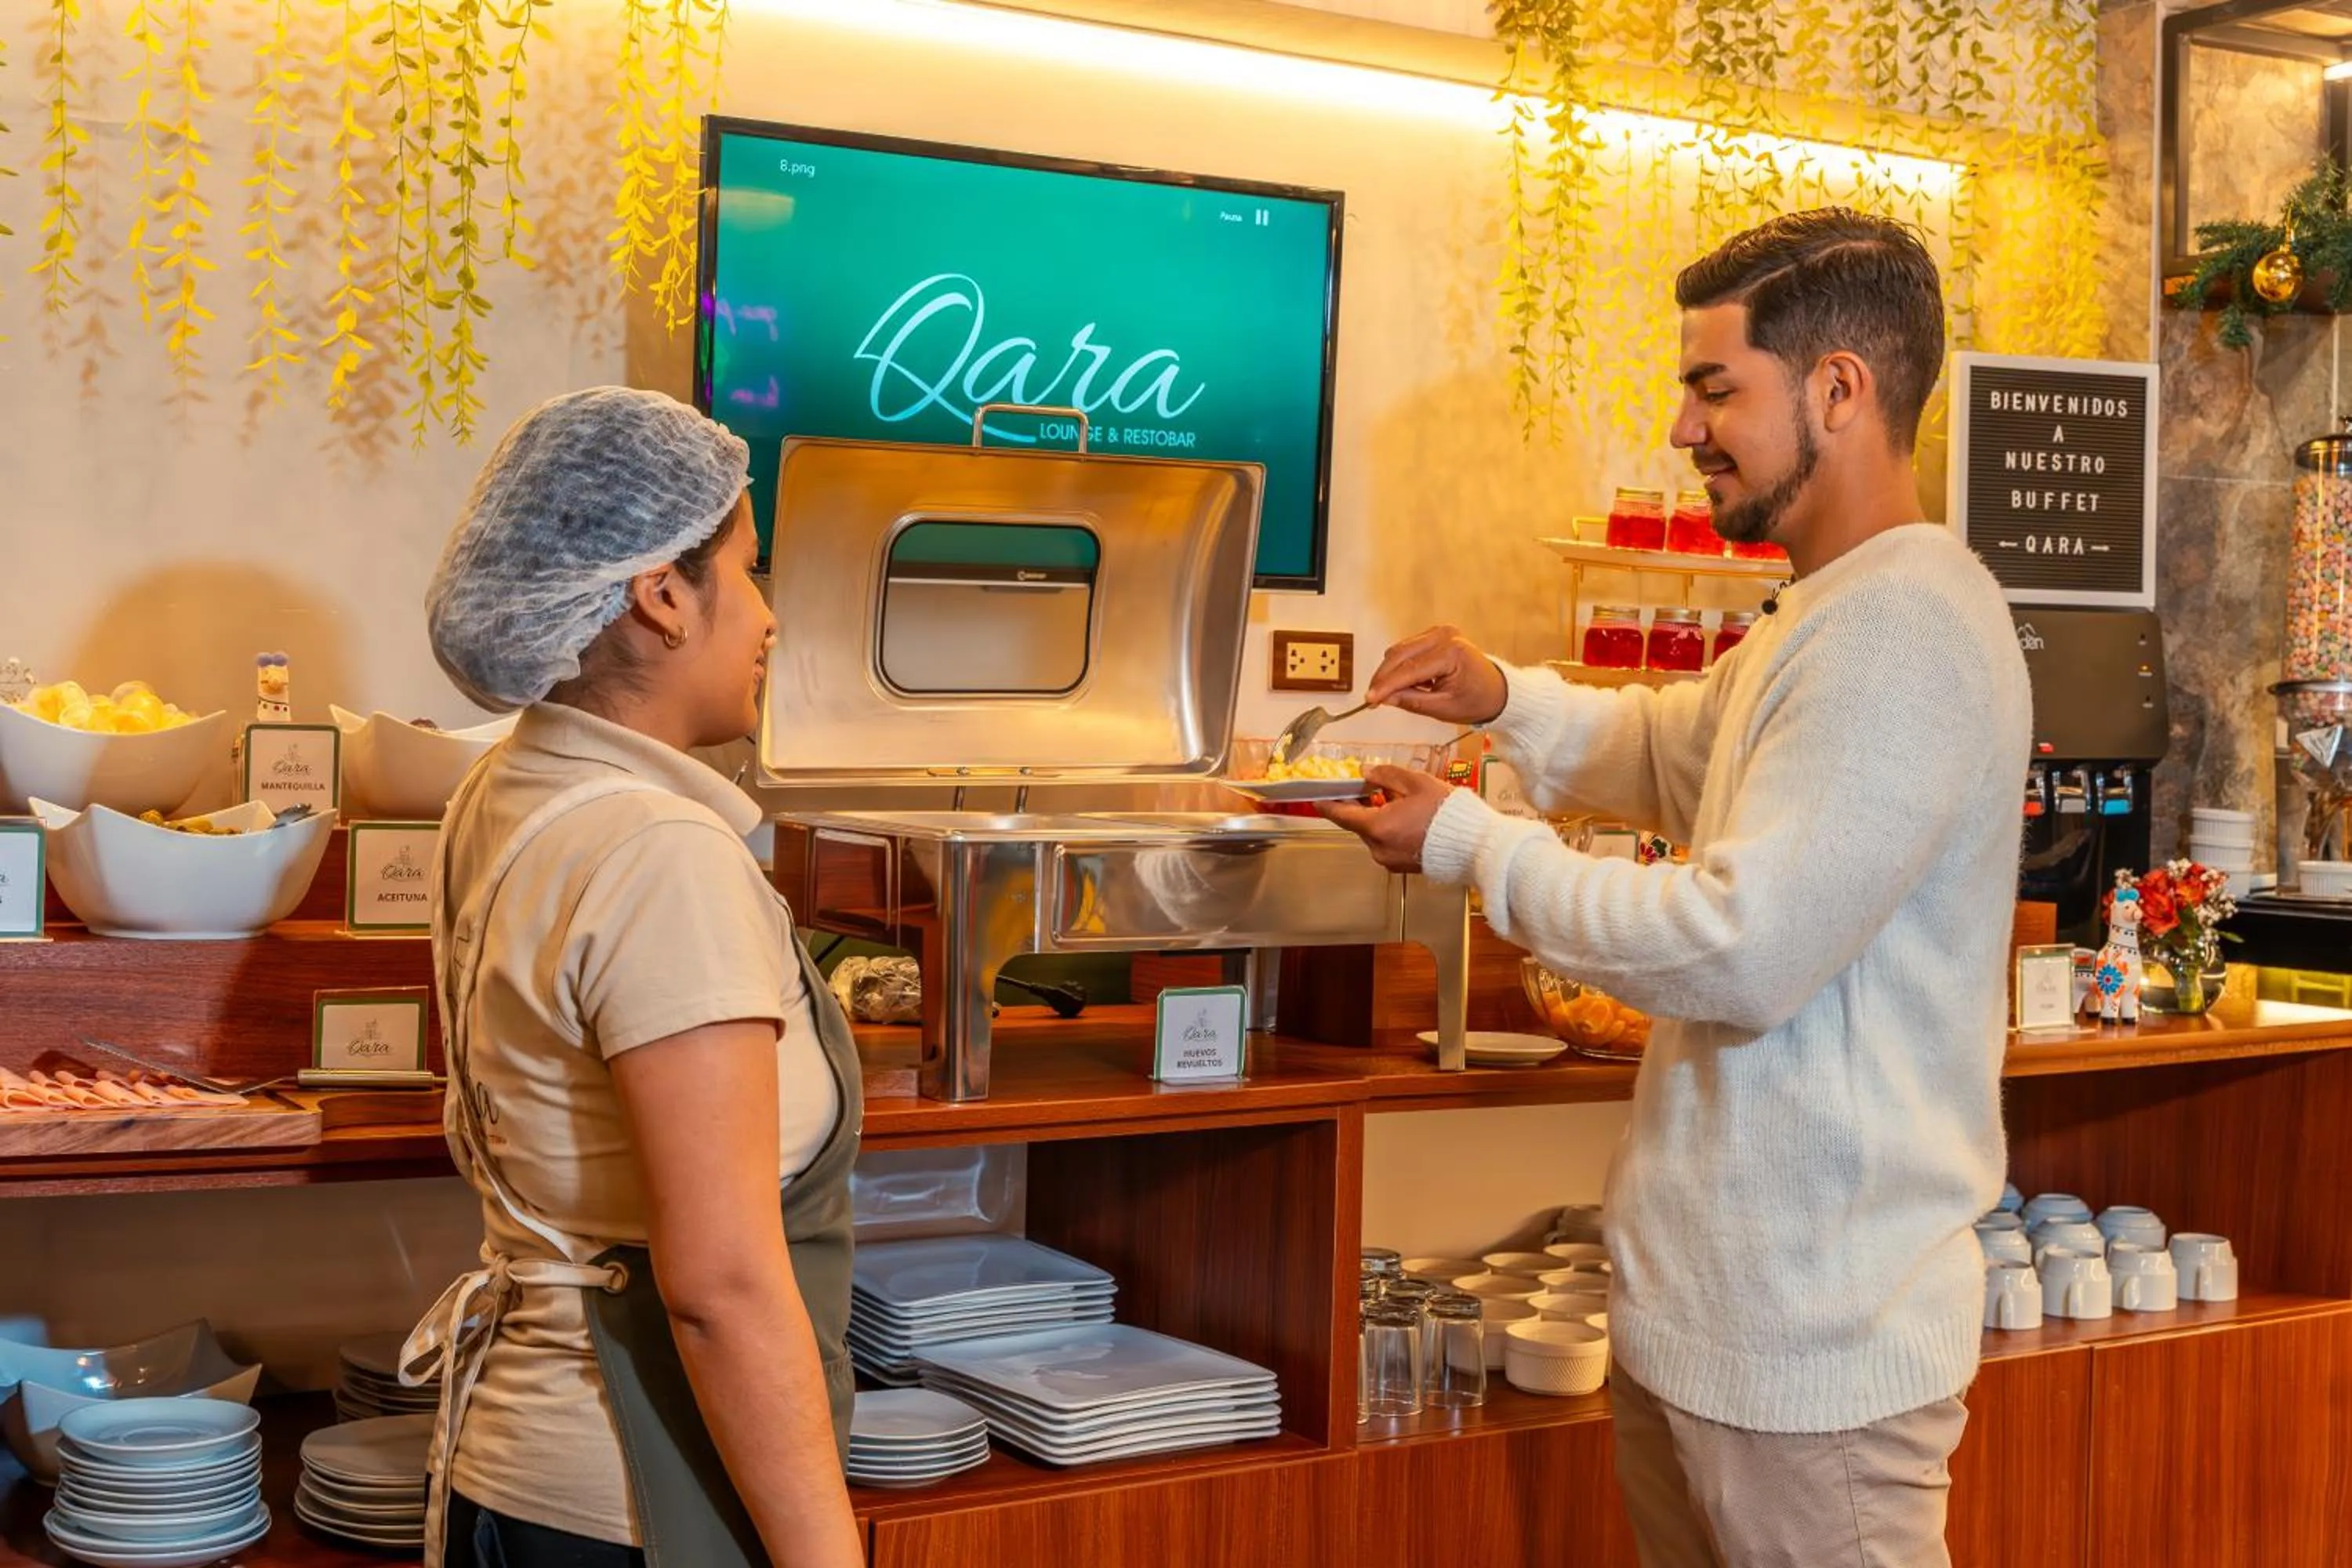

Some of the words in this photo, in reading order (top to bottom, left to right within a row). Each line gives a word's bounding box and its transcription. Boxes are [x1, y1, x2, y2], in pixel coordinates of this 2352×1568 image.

[779, 158, 815, 179] 8.png
[853, 272, 1206, 443] Qara
[1990, 390, 2129, 417] BIENVENIDOS
[1107, 426, 1120, 444] &
[1123, 428, 1196, 448] RESTOBAR
[2052, 424, 2064, 444] A
[2005, 451, 2106, 474] NUESTRO
[2010, 490, 2100, 512] BUFFET
[2024, 535, 2085, 555] QARA
[260, 782, 326, 791] MANTEQUILLA
[376, 892, 428, 902] ACEITUNA
